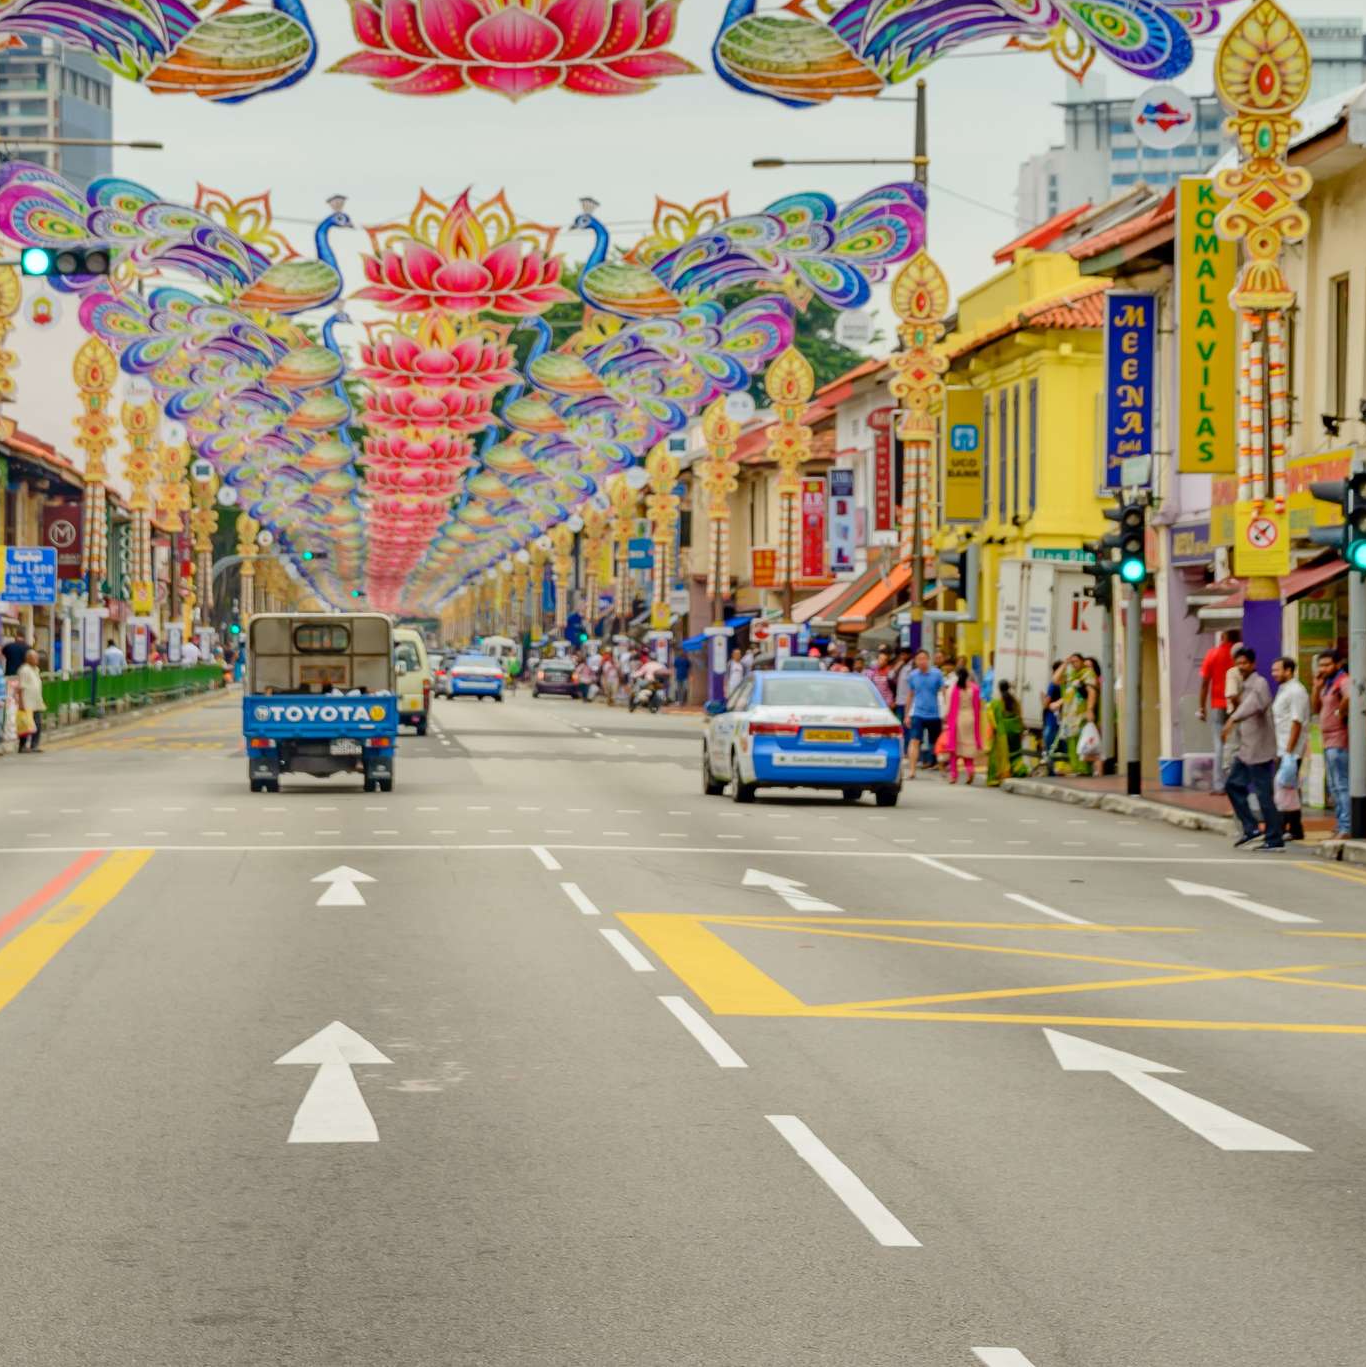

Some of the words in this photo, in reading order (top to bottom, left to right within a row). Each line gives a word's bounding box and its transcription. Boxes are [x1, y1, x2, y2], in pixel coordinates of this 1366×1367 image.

[1194, 184, 1220, 329] KOMALA
[1114, 304, 1146, 435] MEENA
[1196, 341, 1217, 463] VILAS
[270, 706, 371, 722] TOYOTA
